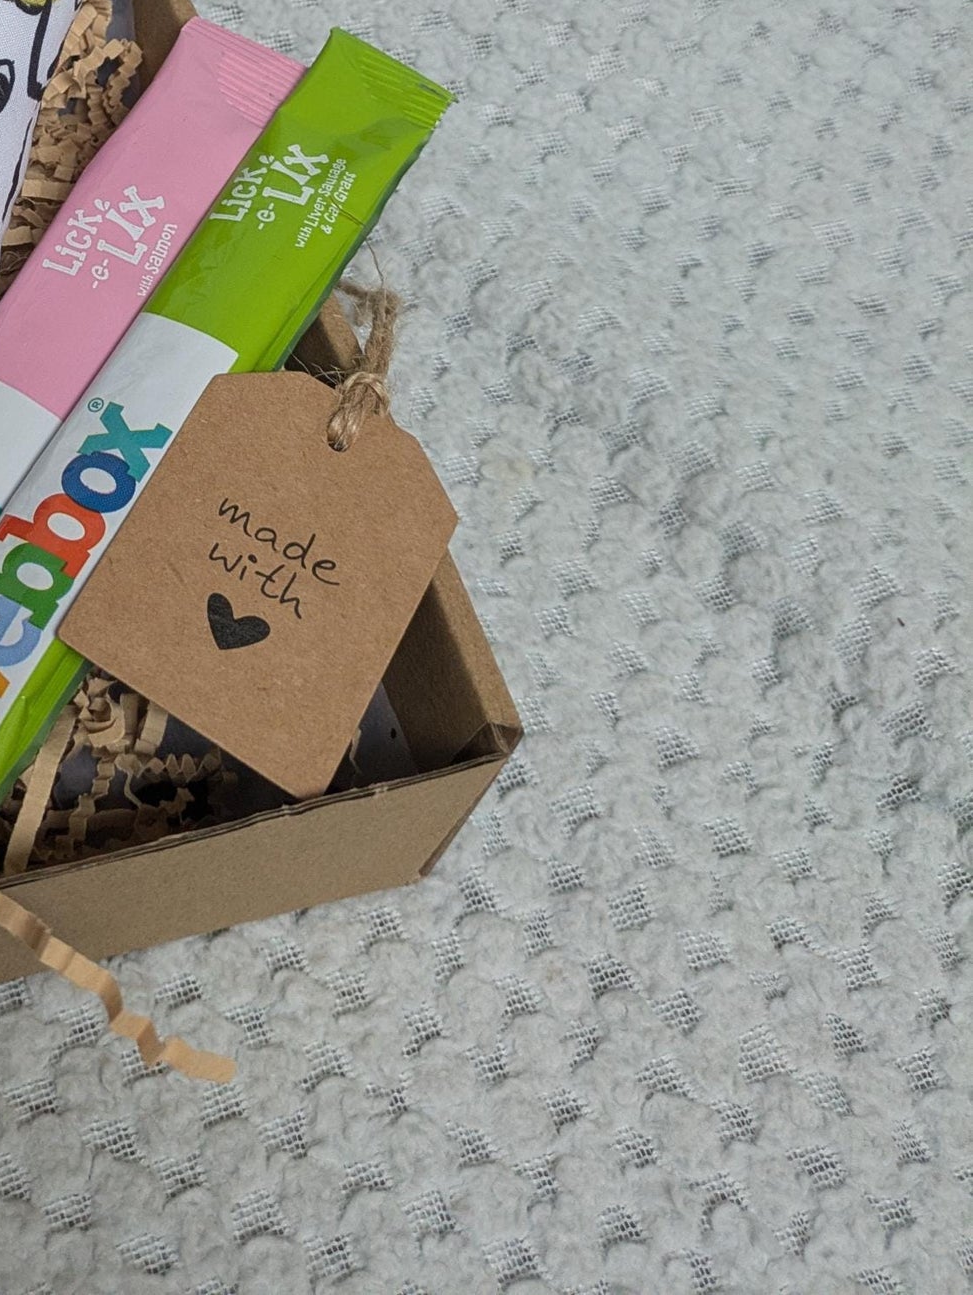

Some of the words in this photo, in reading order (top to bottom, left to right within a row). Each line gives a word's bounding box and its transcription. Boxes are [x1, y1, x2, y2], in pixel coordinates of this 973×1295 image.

[209, 166, 268, 222] Lick
[295, 225, 313, 248] with
[304, 196, 327, 228] Liver
[318, 157, 347, 196] Sausage
[320, 224, 332, 235] &
[333, 172, 357, 203] Grass
[42, 208, 103, 276] Lick
[144, 223, 178, 275] Salmon
[137, 273, 154, 297] with
[218, 497, 340, 586] made
[208, 542, 302, 620] with
